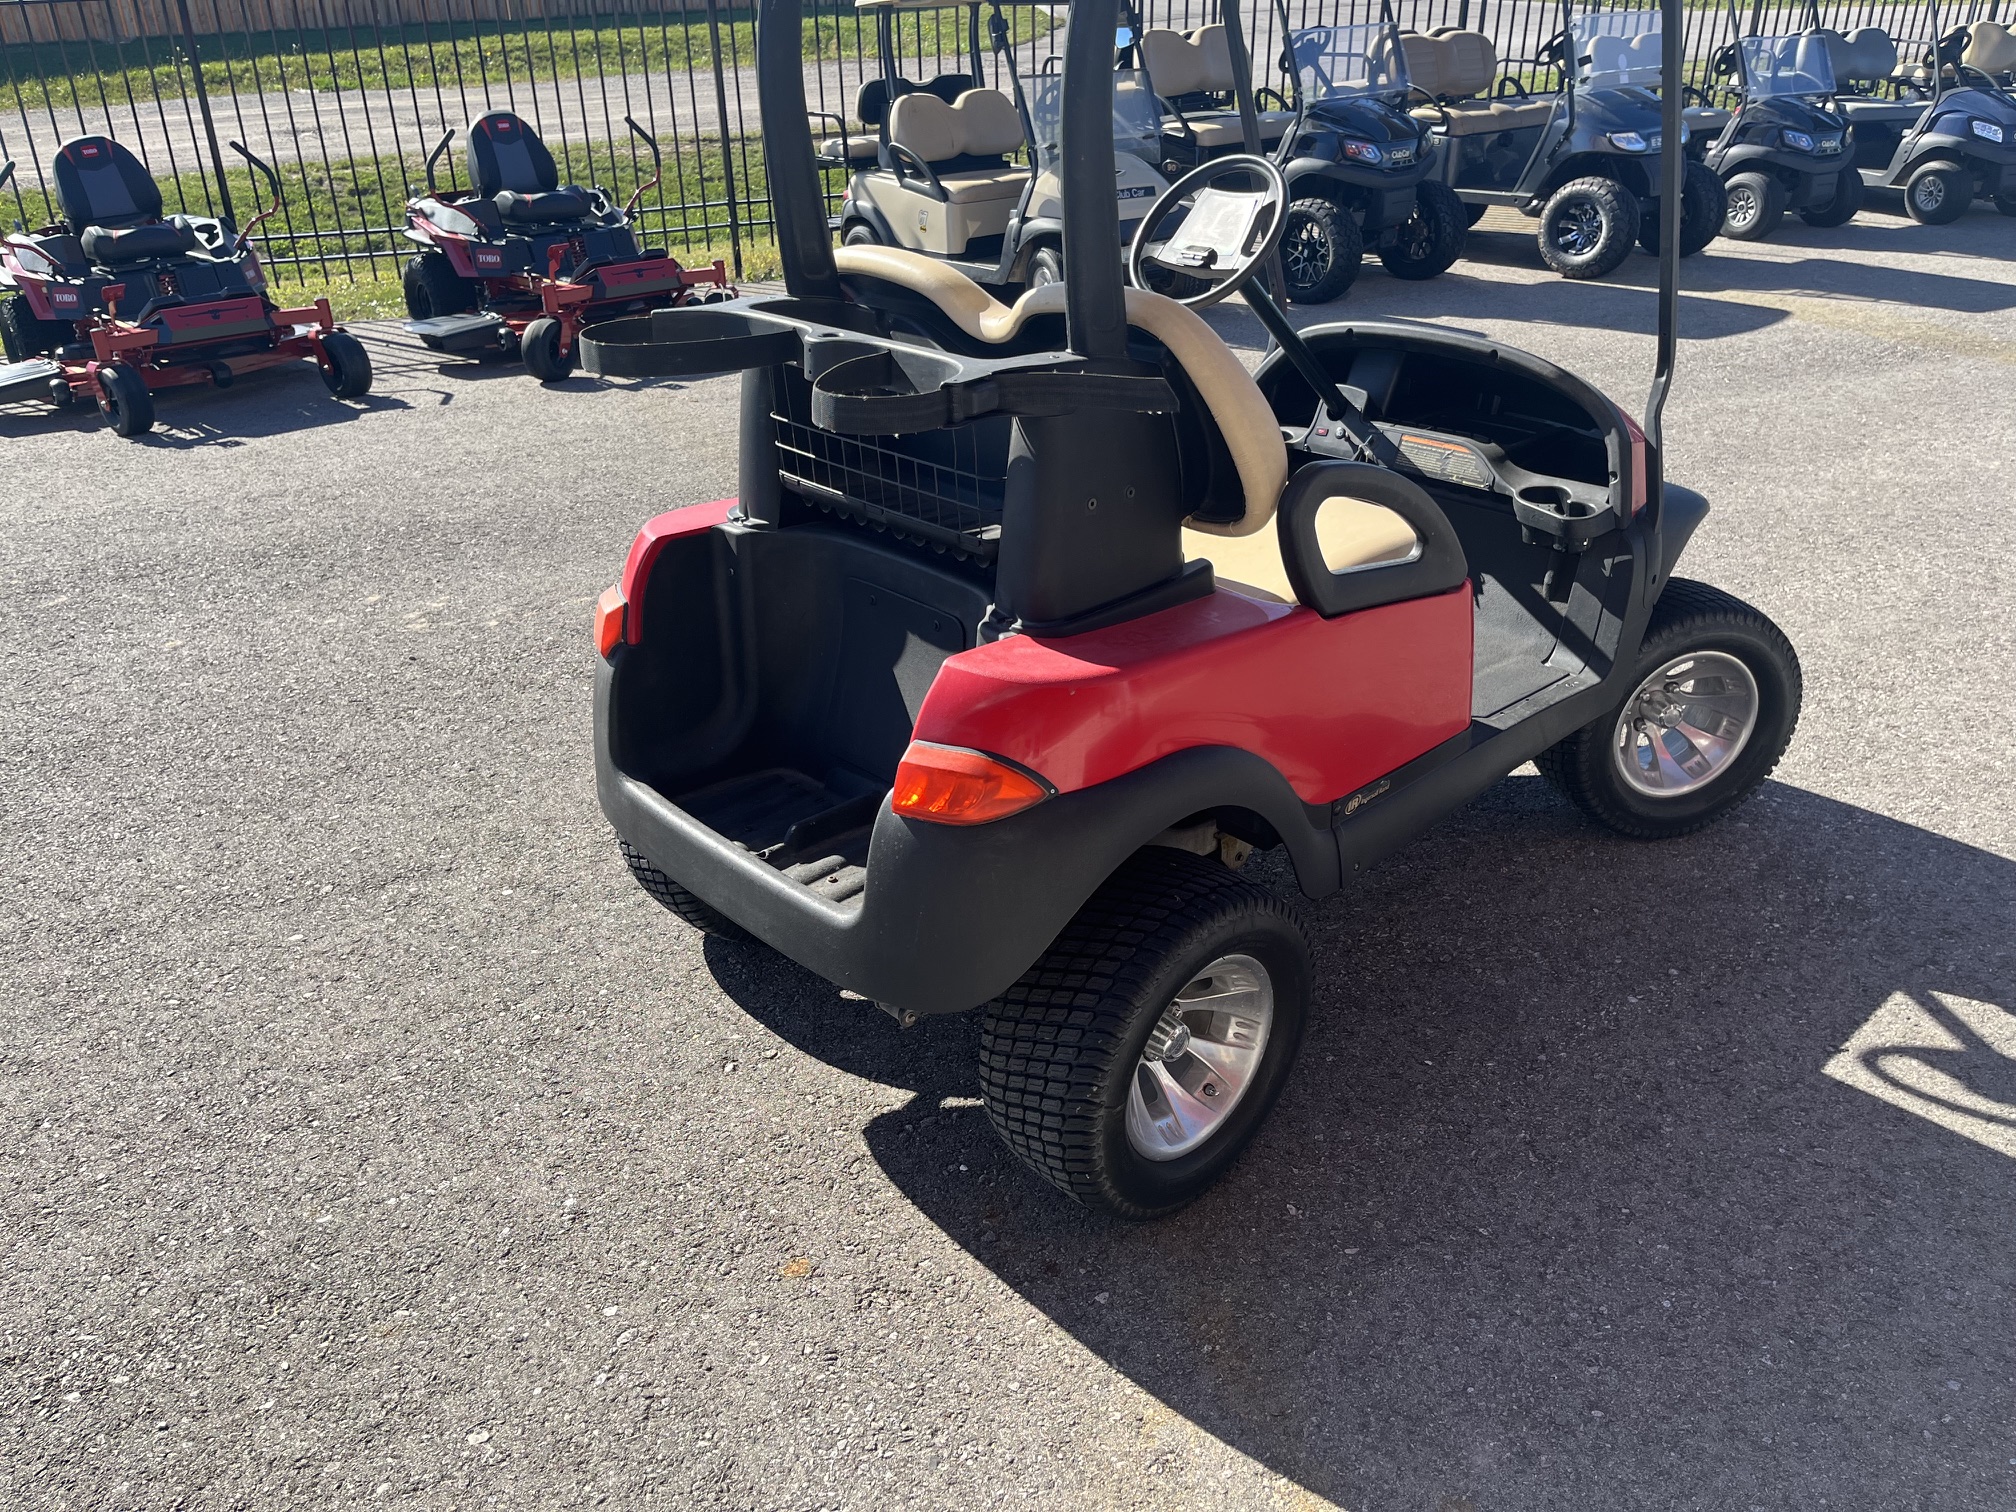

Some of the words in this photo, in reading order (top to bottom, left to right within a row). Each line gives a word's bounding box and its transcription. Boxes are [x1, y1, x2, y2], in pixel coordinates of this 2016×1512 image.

[1131, 188, 1145, 197] Car
[478, 254, 500, 263] TORO
[54, 294, 78, 302] TORO
